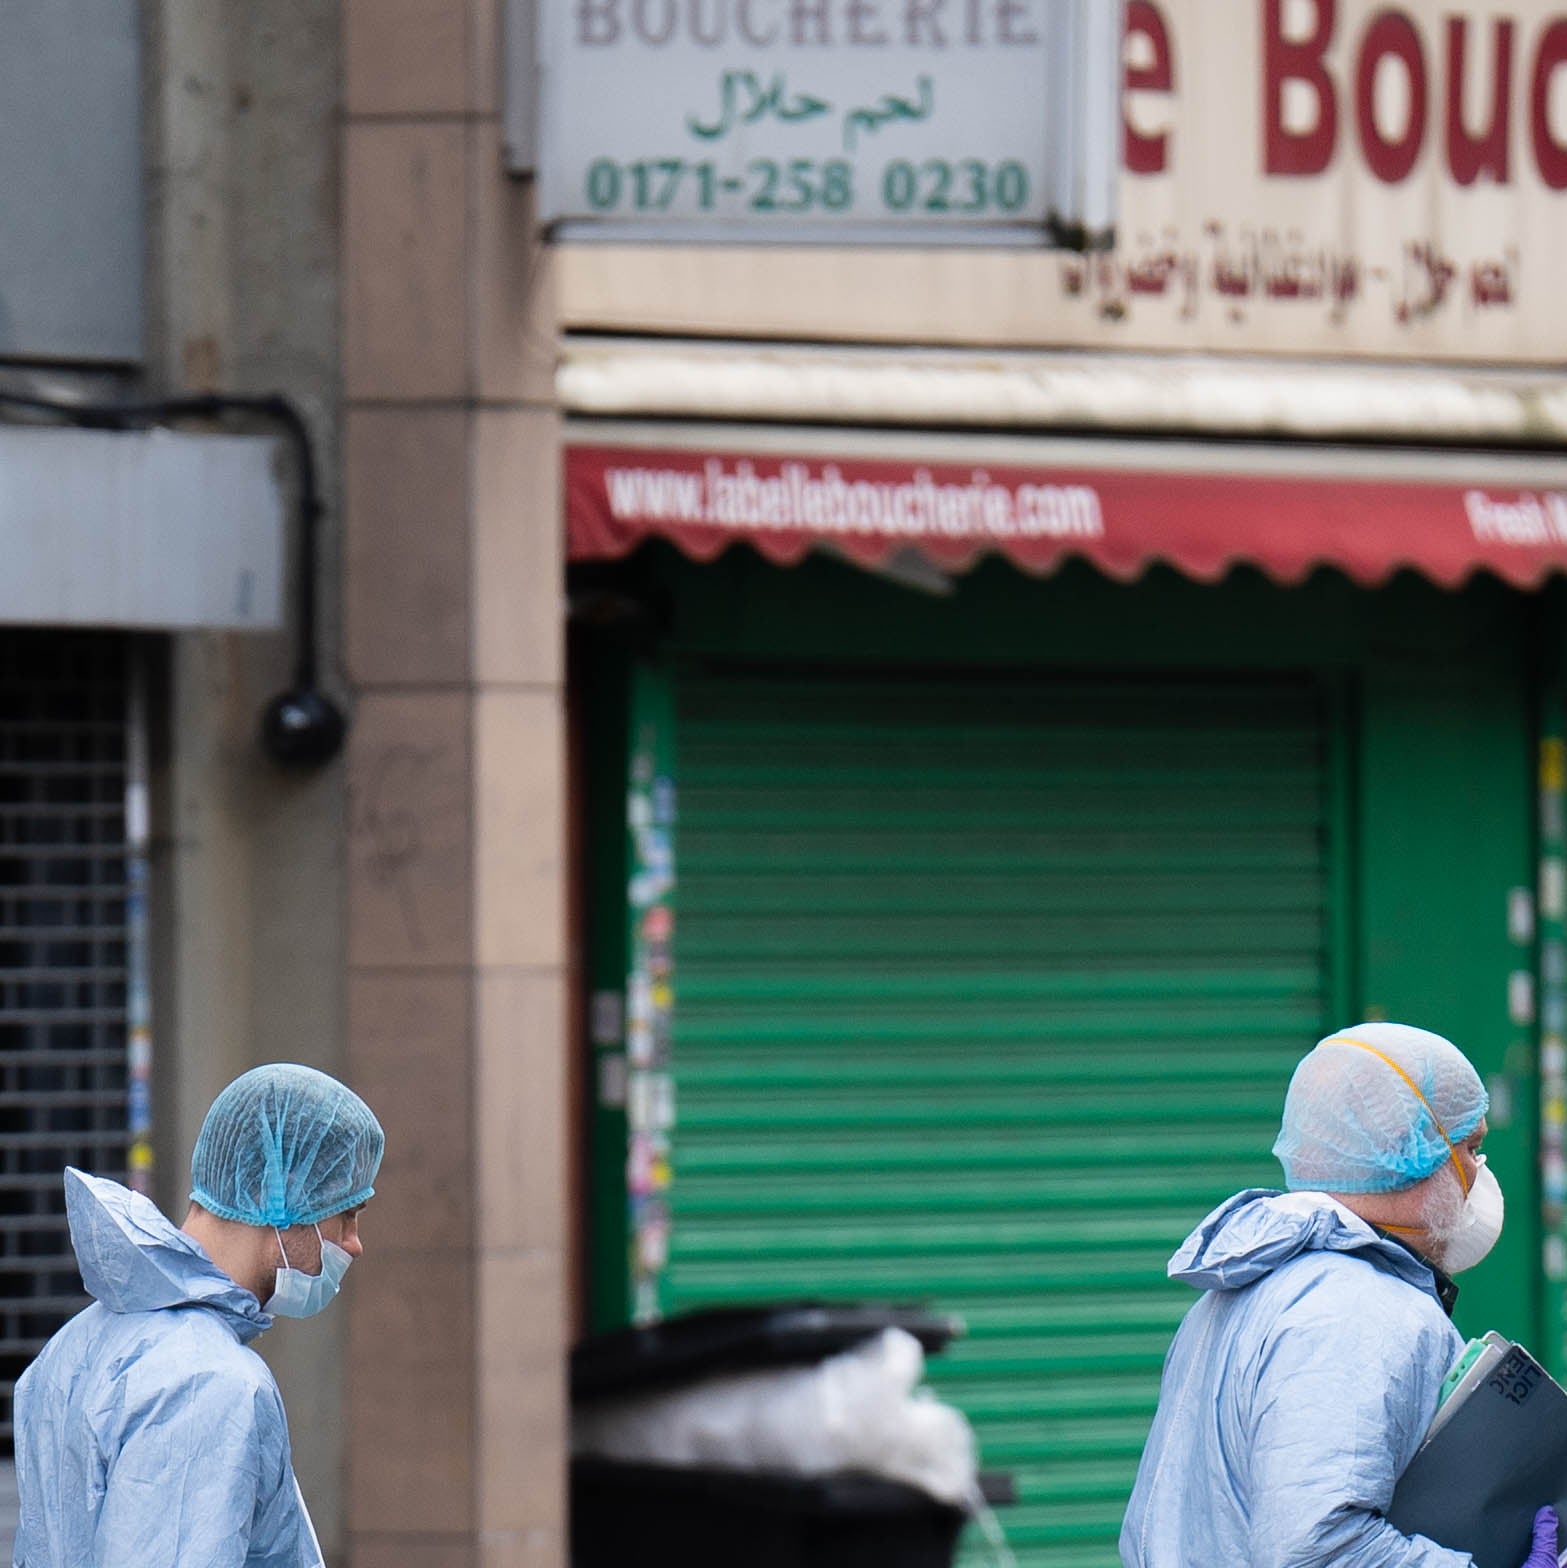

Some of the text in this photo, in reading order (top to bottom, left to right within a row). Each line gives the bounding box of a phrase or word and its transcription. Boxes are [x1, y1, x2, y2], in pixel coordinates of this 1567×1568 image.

[575, 0, 1041, 47] BOUCHERIE
[586, 158, 1029, 212] 0171-258 0230
[604, 459, 1104, 538] www.labelleboucherie.com
